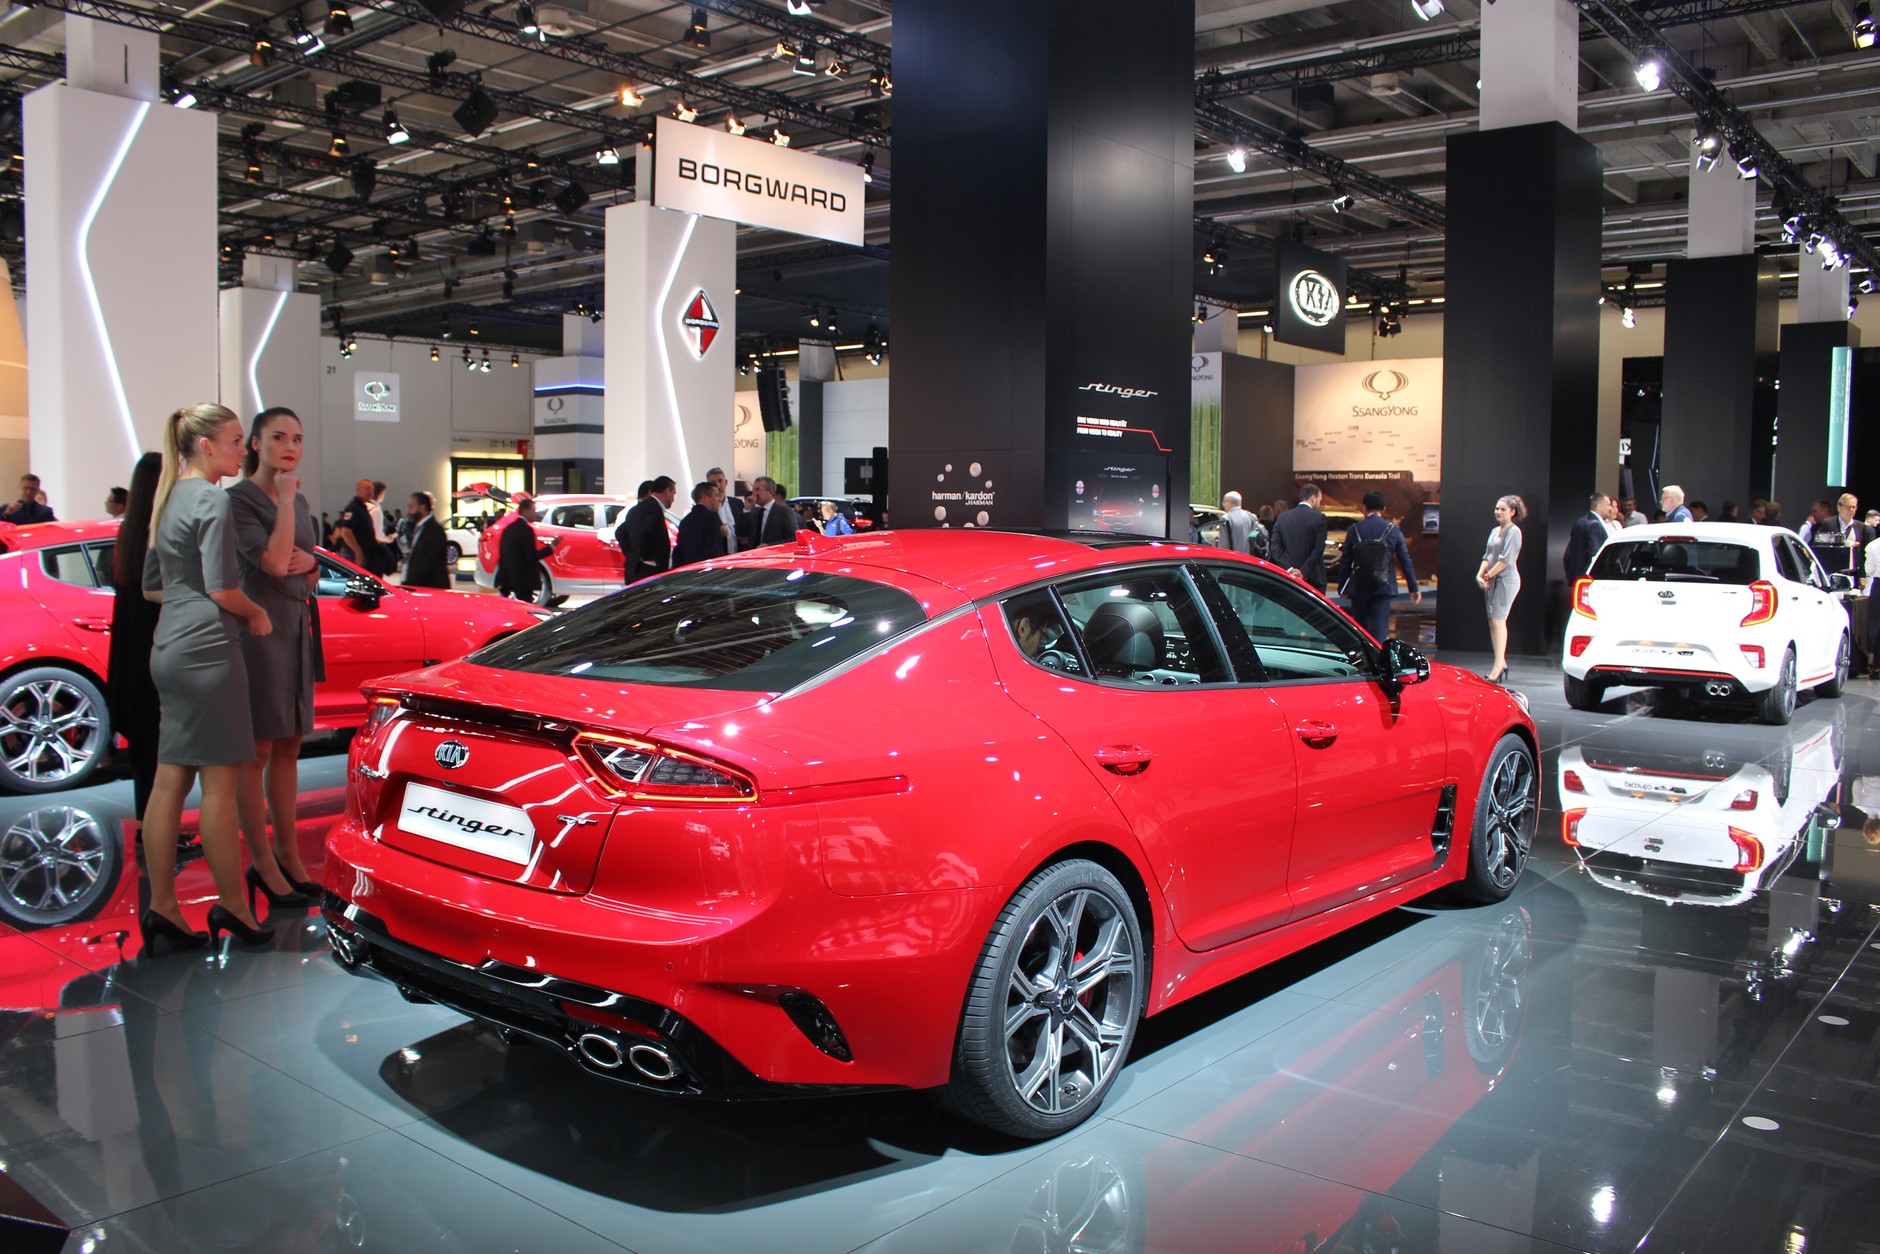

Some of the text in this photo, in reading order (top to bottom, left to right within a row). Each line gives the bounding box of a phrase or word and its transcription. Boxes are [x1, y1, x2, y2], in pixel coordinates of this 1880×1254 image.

[679, 157, 846, 213] BORGWARD
[326, 366, 336, 374] 21
[1079, 383, 1158, 398] stinger
[1328, 472, 1349, 480] Rexton
[1348, 472, 1364, 480] Trans
[1364, 472, 1388, 480] Eurasia
[1388, 472, 1400, 480] Trail
[437, 742, 462, 763] KIA
[407, 805, 525, 837] stinger
